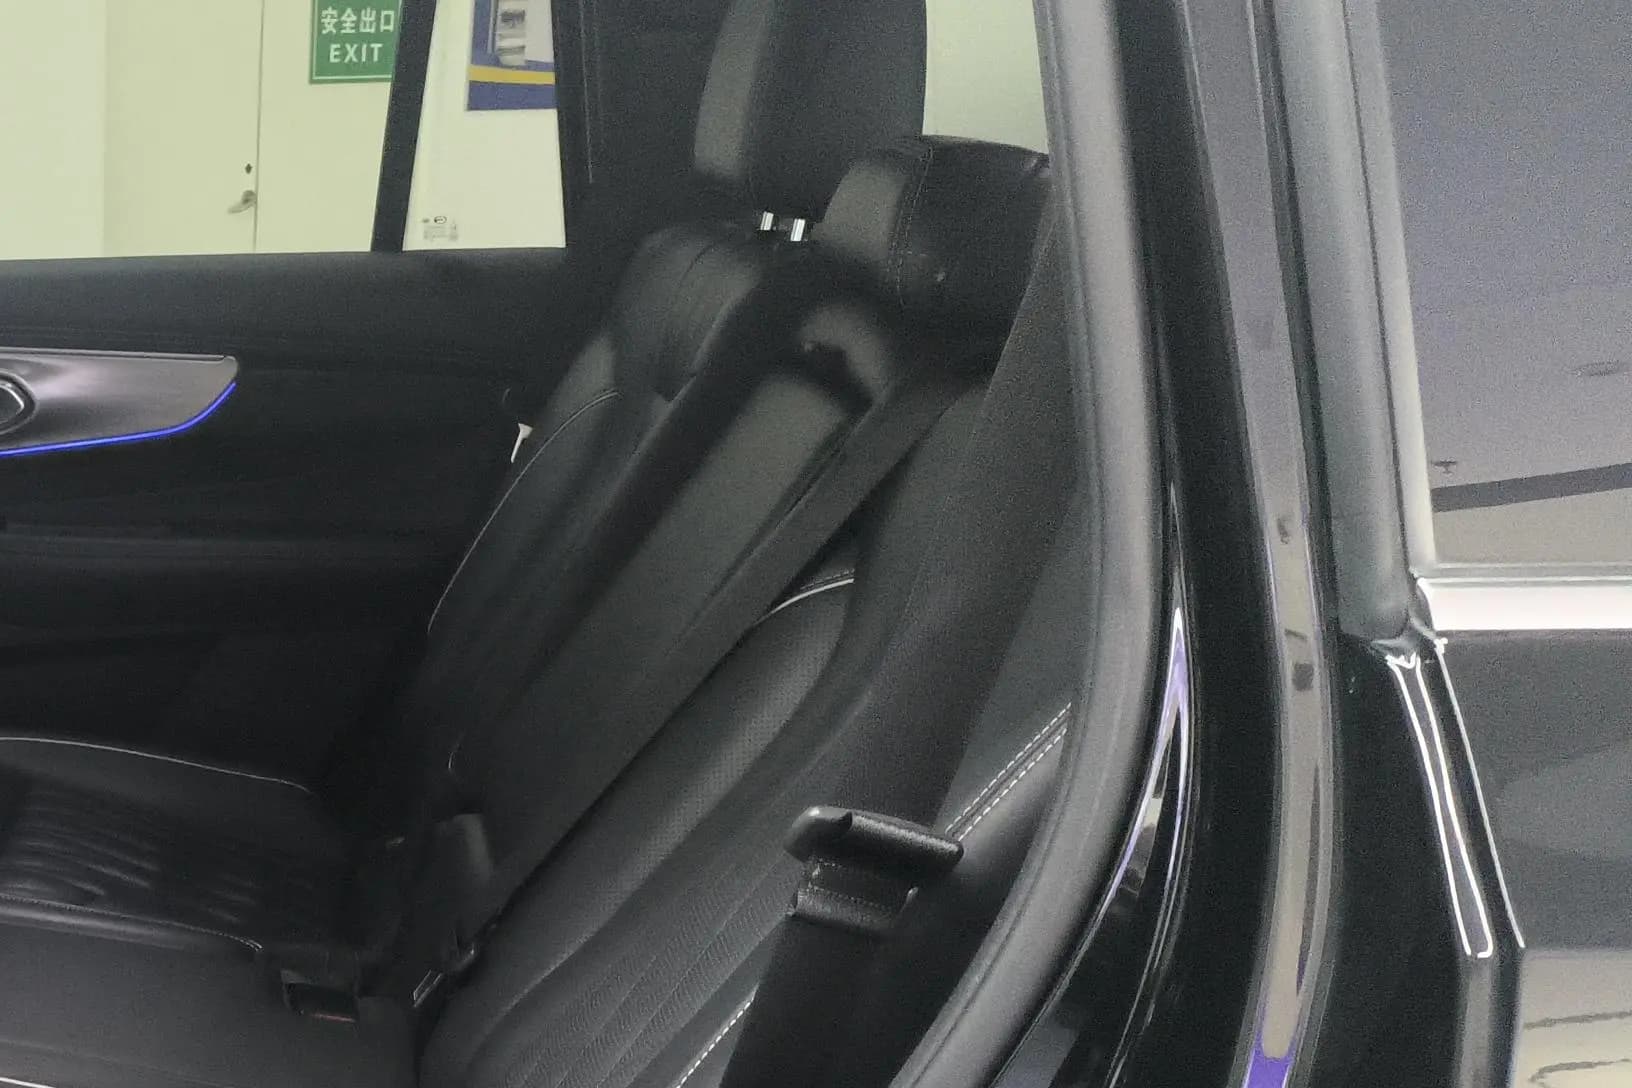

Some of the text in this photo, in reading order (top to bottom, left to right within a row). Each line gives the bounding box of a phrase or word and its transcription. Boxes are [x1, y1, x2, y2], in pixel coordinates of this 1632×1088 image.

[321, 8, 395, 34] 安全出口
[329, 43, 383, 64] EXIT
